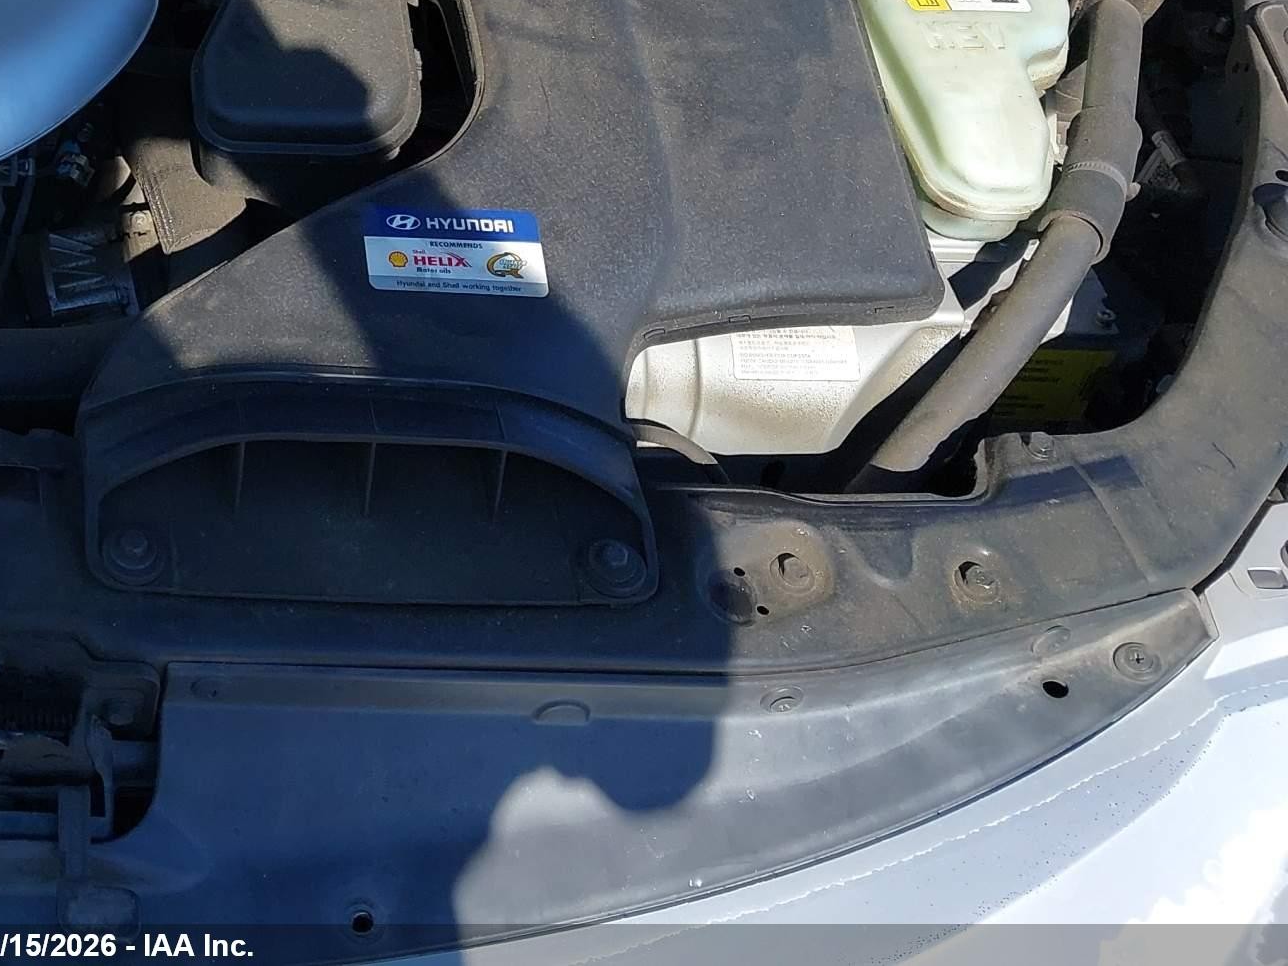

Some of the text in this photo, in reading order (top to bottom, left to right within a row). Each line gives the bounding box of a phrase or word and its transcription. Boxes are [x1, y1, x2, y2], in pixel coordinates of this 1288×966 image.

[426, 217, 515, 234] HYUNDAI
[430, 241, 483, 249] RECOMMENDS
[414, 254, 469, 267] HELIX
[396, 280, 425, 289] Hyundai
[462, 283, 490, 292] working
[492, 284, 522, 292] together
